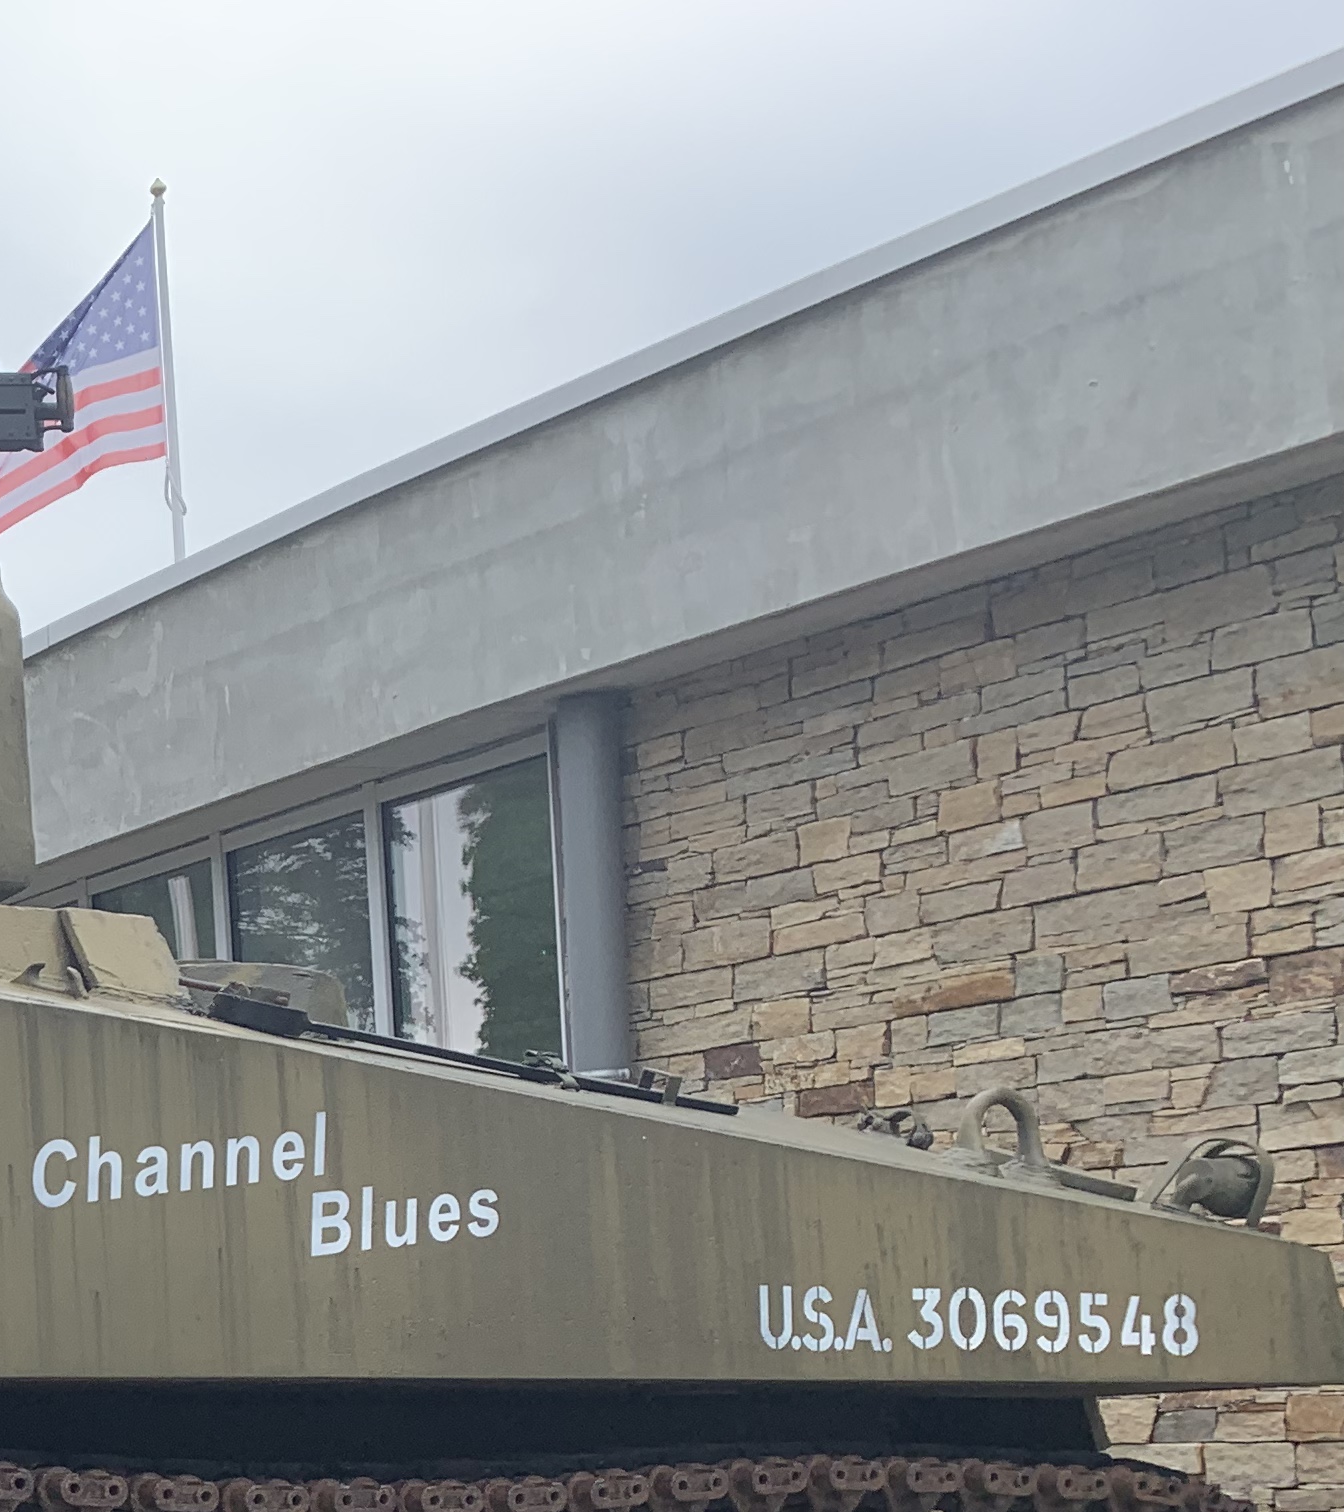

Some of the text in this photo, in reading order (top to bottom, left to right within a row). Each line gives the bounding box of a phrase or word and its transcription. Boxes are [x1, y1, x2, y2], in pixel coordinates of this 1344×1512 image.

[32, 1111, 326, 1208] Channel
[311, 1187, 500, 1257] Blues
[759, 1284, 1199, 1356] U.S.A. 3069548
